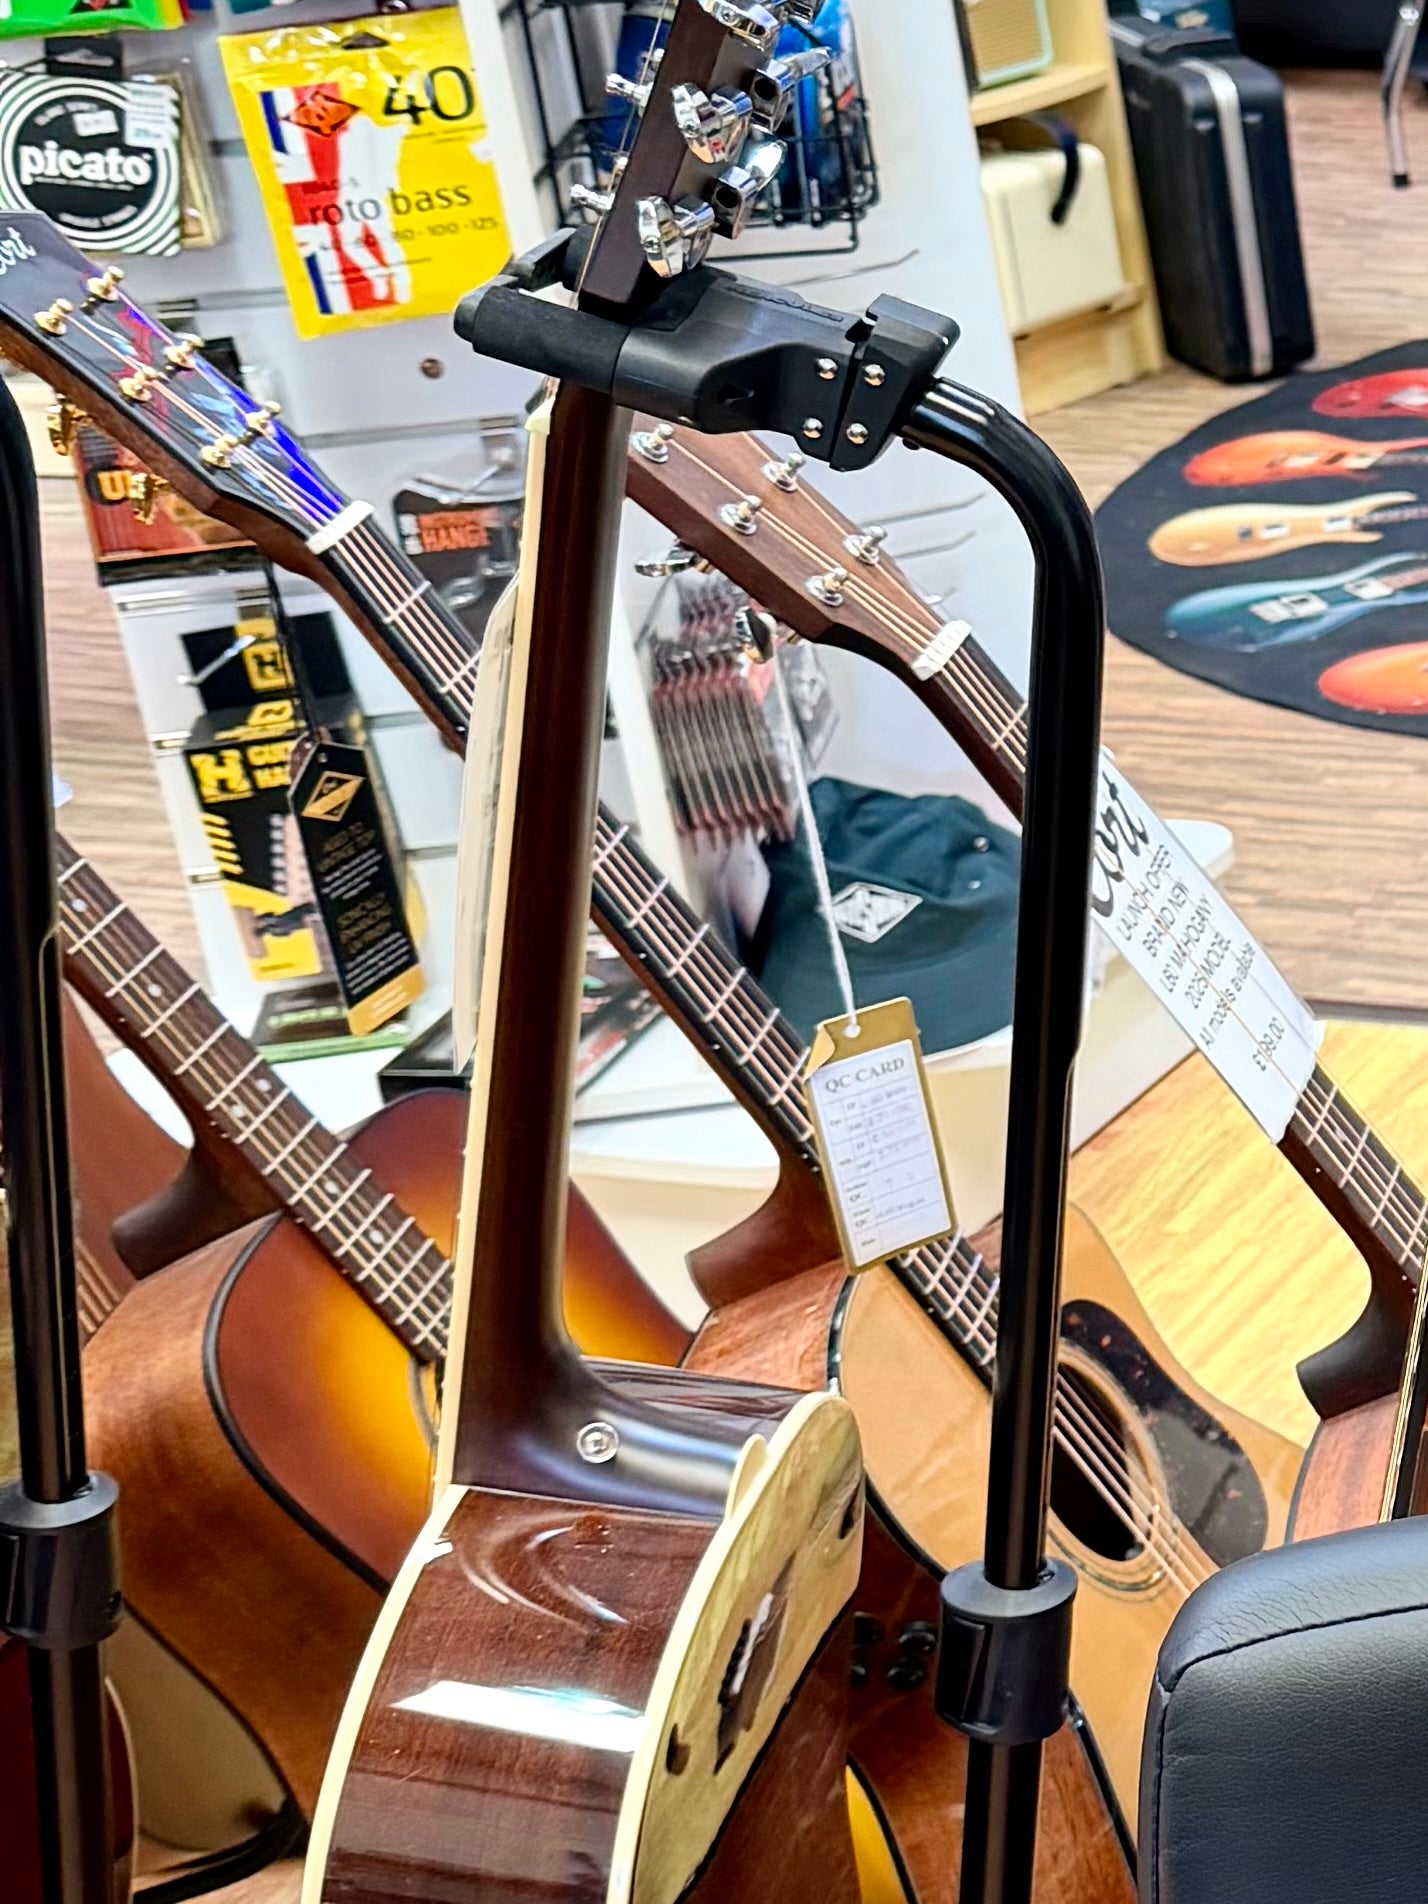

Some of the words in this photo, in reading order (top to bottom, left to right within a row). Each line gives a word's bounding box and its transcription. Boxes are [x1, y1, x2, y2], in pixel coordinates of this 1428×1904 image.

[383, 66, 475, 125] 40
[19, 140, 151, 186] picato
[310, 197, 381, 226] roto
[389, 185, 472, 216] bass
[189, 746, 252, 804] H
[1116, 881, 1156, 942] LAUNCH
[1150, 844, 1173, 890] OFFER
[1141, 909, 1175, 958] BRAND
[1172, 878, 1191, 917] NEW
[1173, 894, 1215, 966] MAHOGANY
[1203, 931, 1232, 980] MODEL
[1200, 1026, 1215, 1050] All
[1211, 985, 1238, 1030] models
[1230, 941, 1257, 1002] available
[1252, 1016, 1286, 1073] £199.00
[824, 1072, 851, 1094] QC
[855, 1056, 906, 1083] CARD
